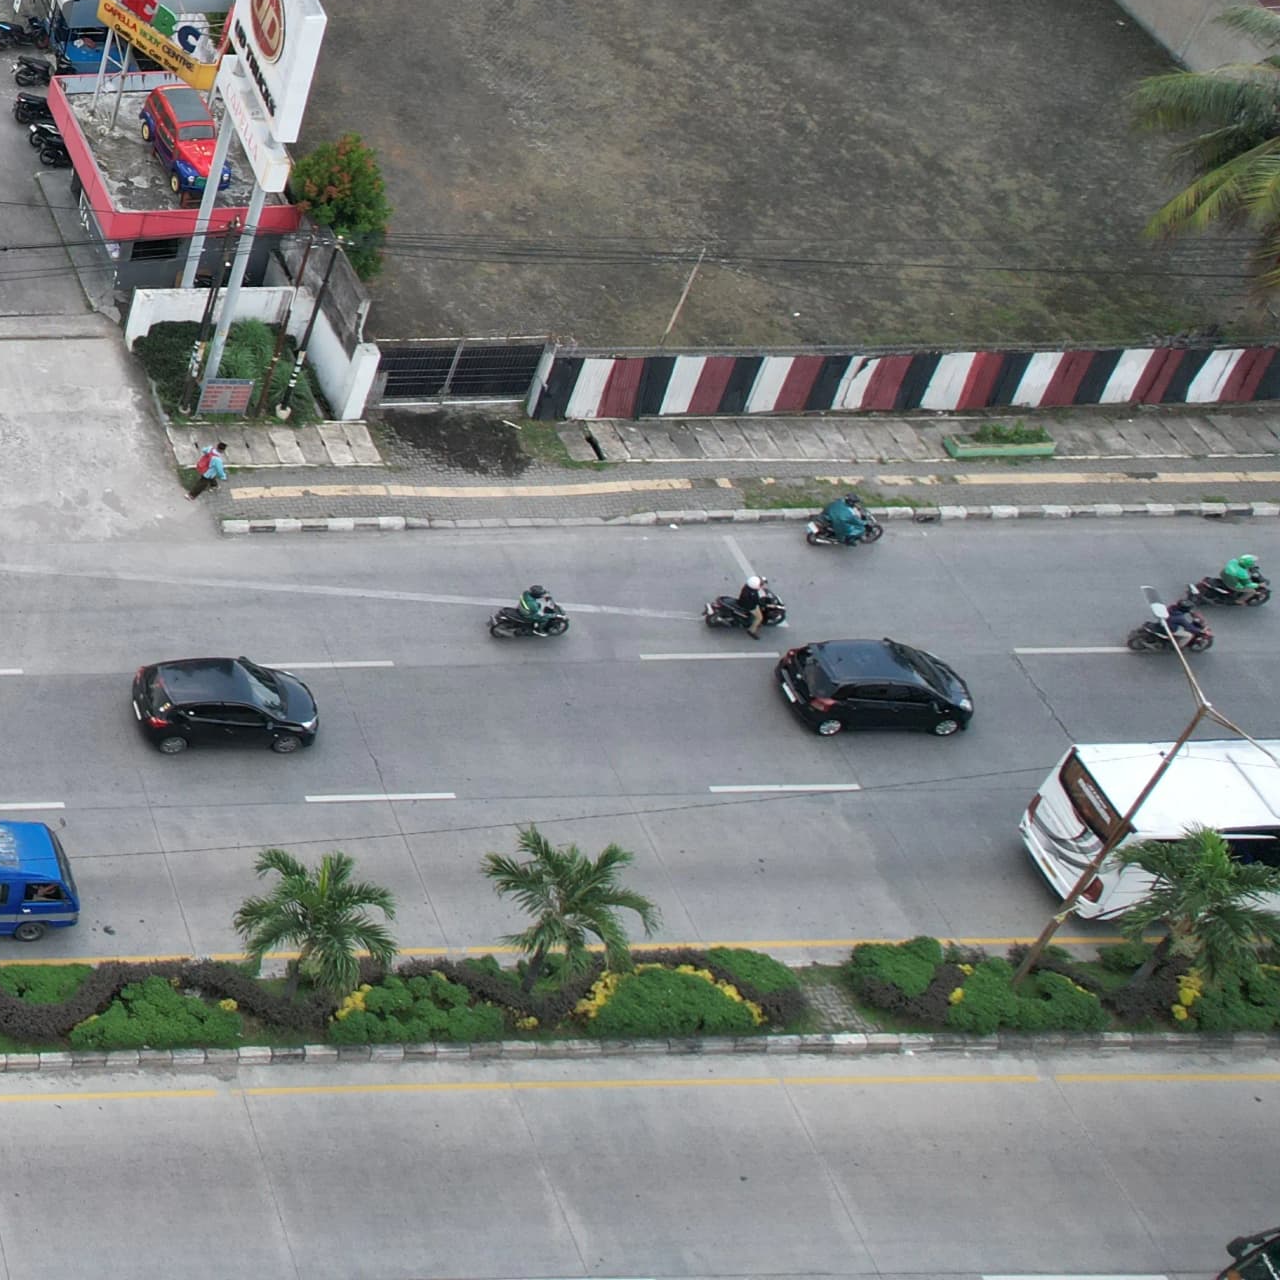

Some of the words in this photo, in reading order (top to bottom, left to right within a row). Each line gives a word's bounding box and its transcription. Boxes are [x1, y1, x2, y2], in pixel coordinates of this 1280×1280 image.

[103, 2, 138, 33] CAPELLA
[161, 44, 195, 72] CENTRE
[226, 83, 259, 163] CAPELLA
